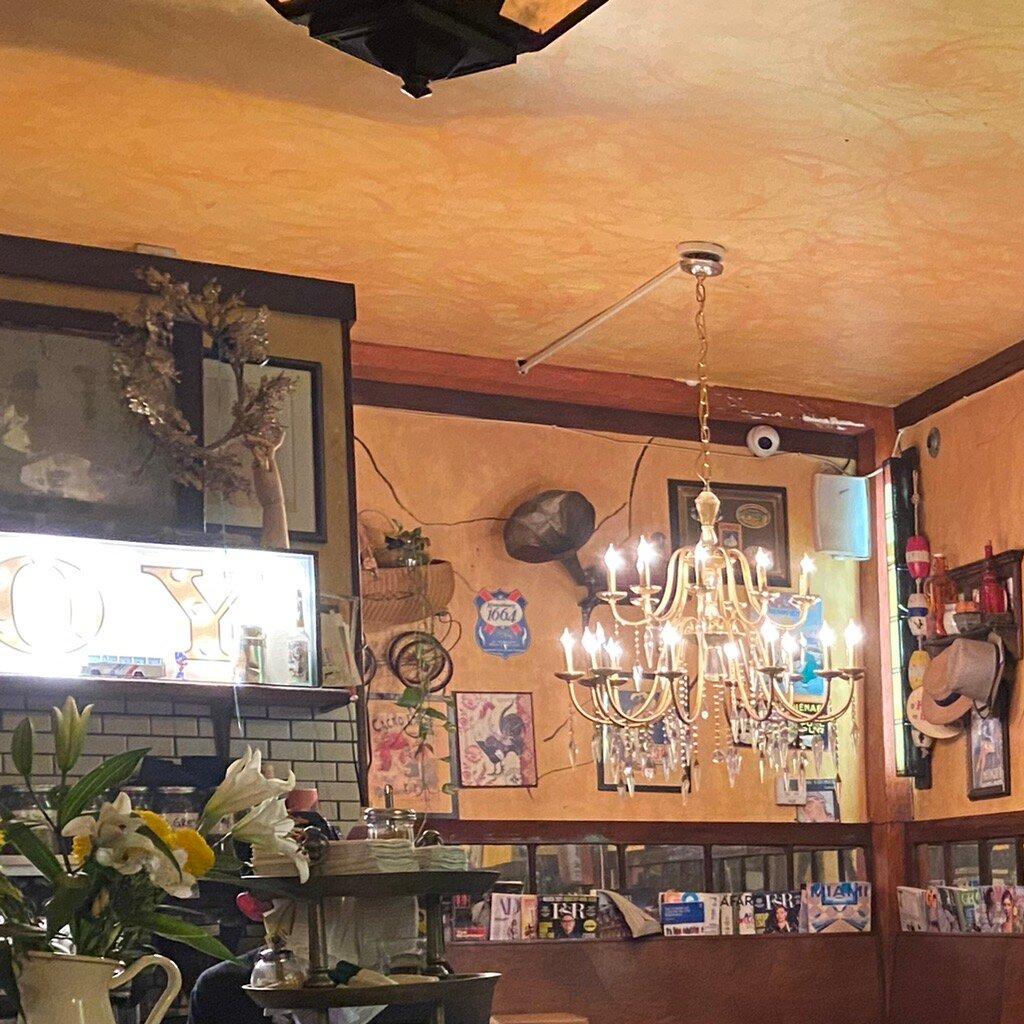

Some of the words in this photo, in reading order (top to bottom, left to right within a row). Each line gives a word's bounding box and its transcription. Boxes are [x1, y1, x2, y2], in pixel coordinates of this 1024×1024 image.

[487, 608, 517, 622] 1664
[810, 882, 869, 899] MIAMI
[720, 894, 753, 907] AFAR
